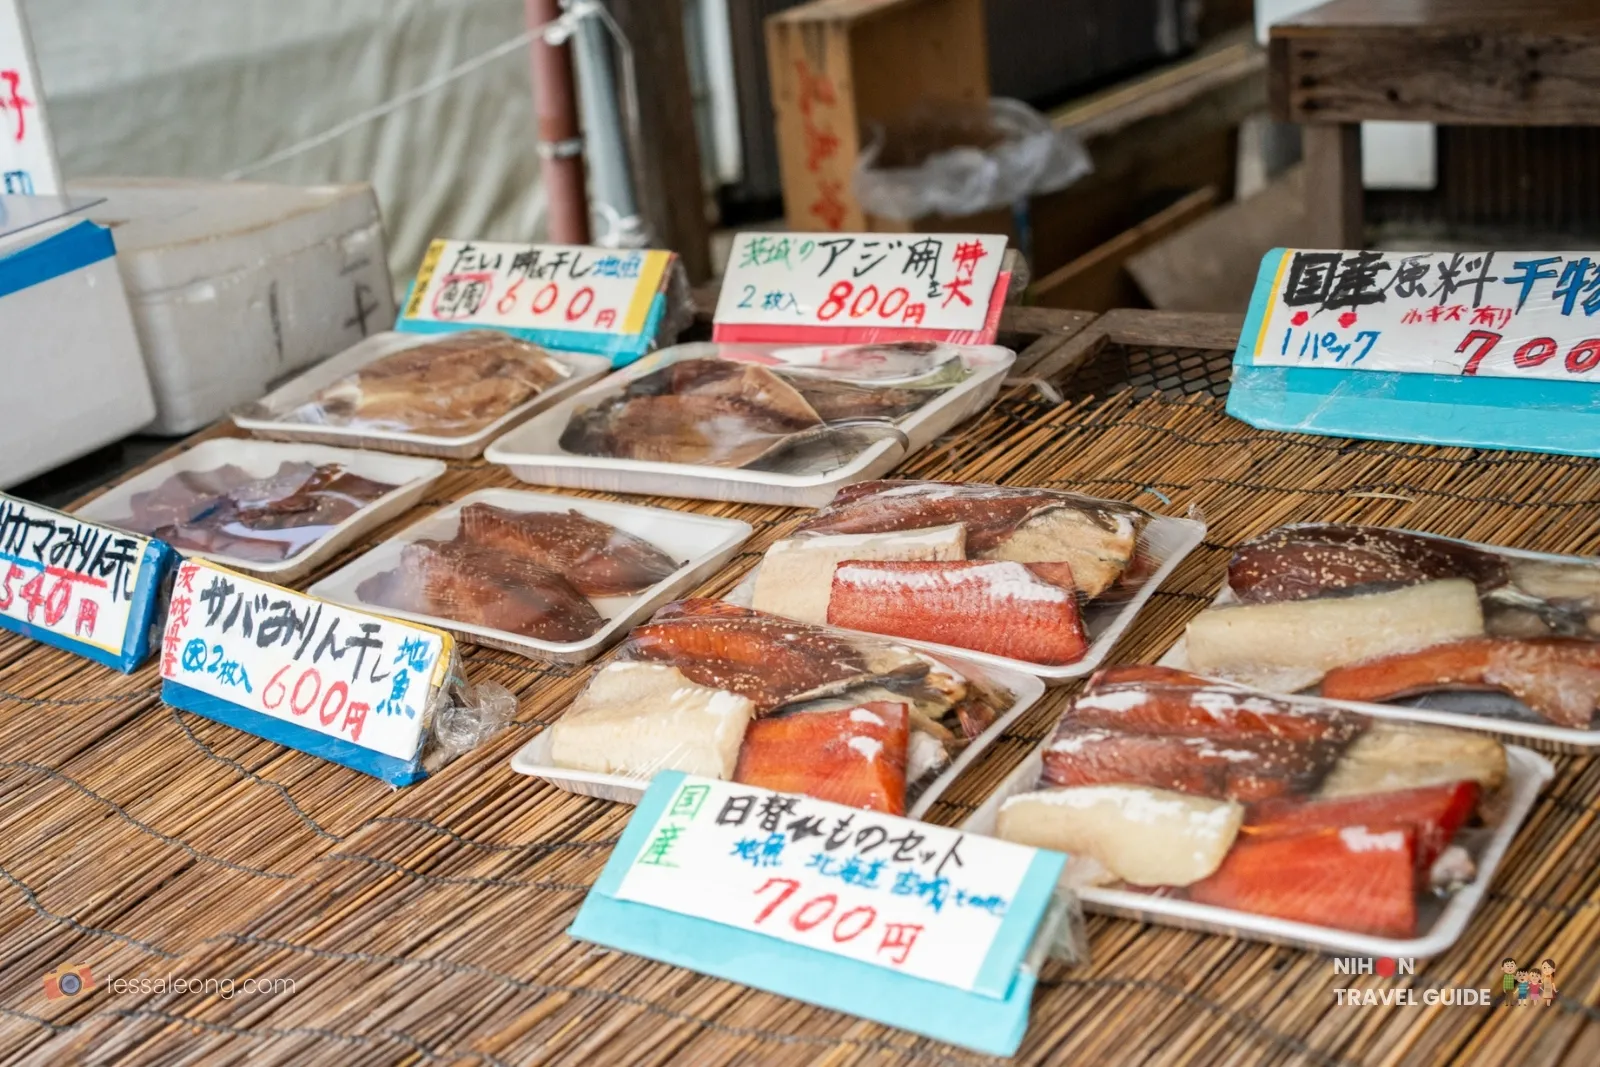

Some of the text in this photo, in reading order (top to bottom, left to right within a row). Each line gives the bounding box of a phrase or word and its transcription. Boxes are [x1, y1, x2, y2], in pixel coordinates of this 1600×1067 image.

[496, 276, 617, 329] 600円
[737, 279, 927, 326] 2枚入 800円
[939, 237, 990, 309] 特大
[1453, 328, 1600, 377] 700
[0, 561, 99, 638] 540円
[161, 563, 200, 678] 茨城県産
[200, 574, 391, 684] サバみりん干し
[261, 664, 371, 742] 600円
[375, 634, 434, 721] 地魚
[637, 783, 711, 869] 国産
[730, 832, 786, 868] 地魚
[805, 853, 889, 889] 北海道
[753, 876, 925, 965] 700円
